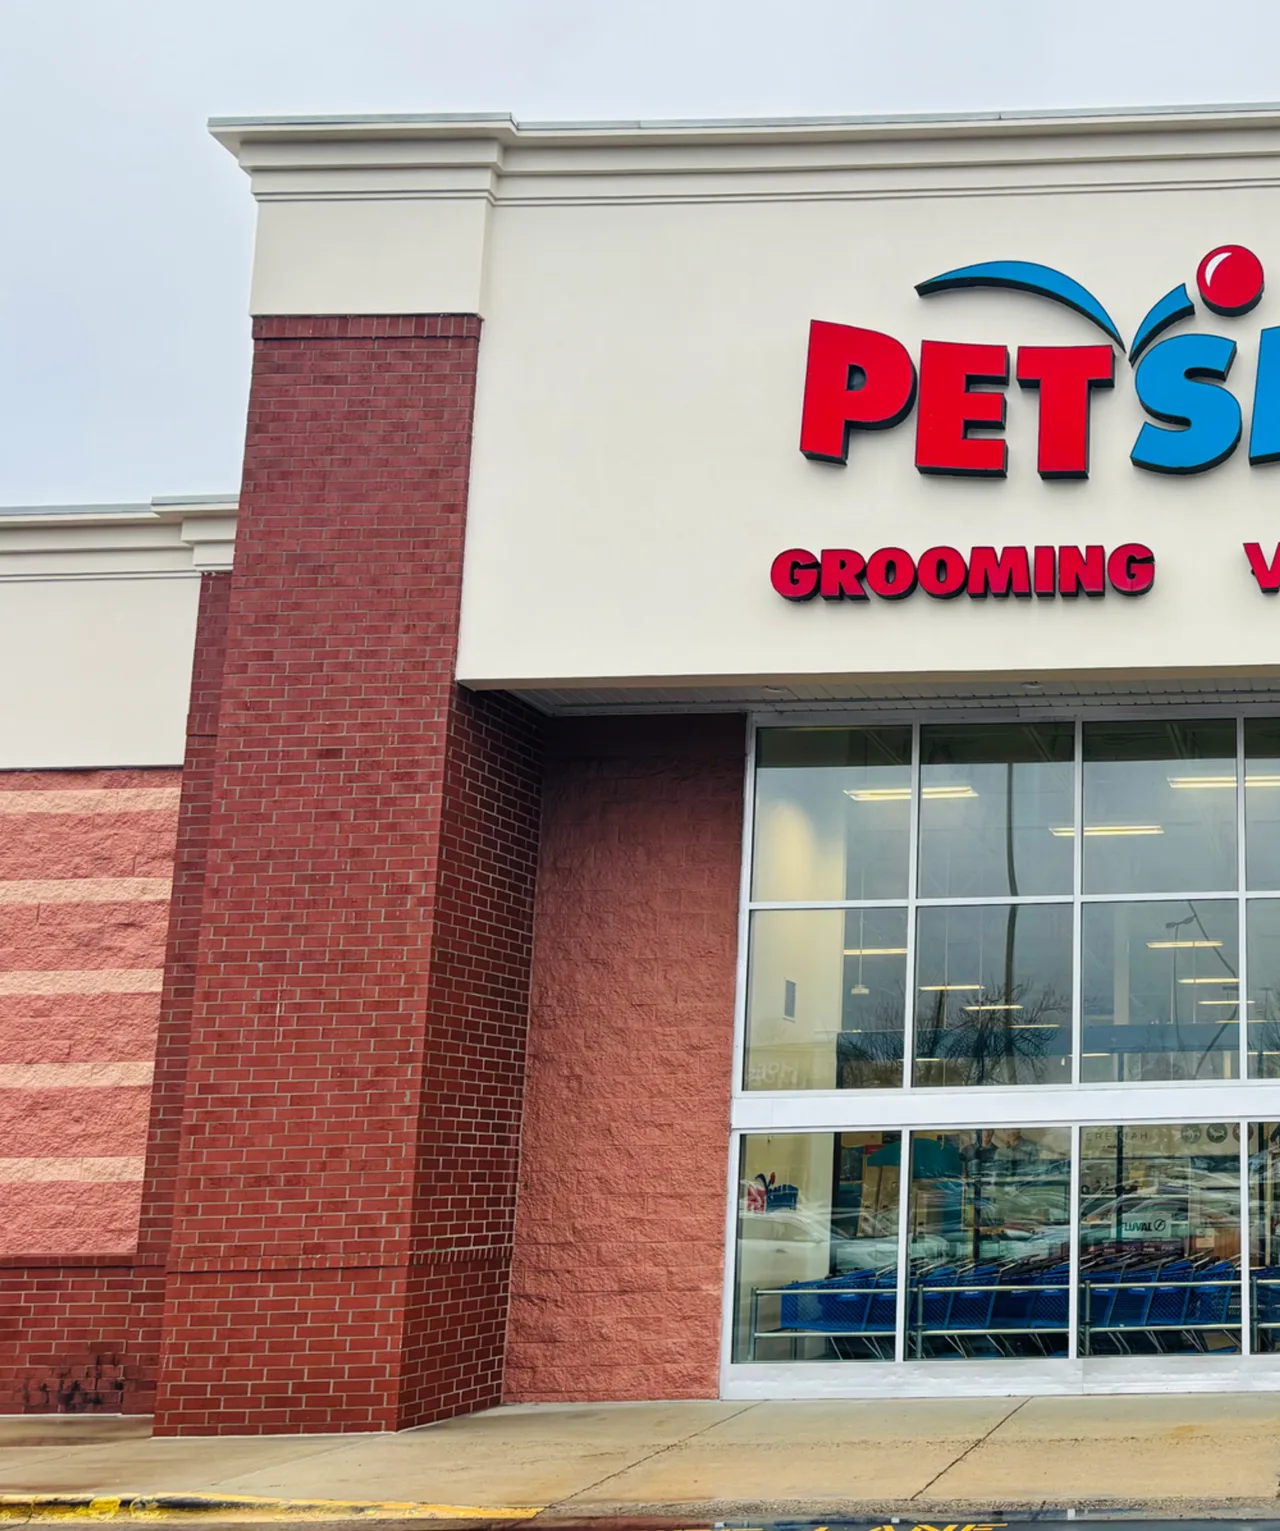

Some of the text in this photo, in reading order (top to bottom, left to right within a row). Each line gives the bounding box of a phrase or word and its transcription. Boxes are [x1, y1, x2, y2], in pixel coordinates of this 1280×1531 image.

[770, 543, 1155, 603] GROOMING
[1086, 1132, 1148, 1141] EREIAH
[814, 1523, 1008, 1531] ANE
